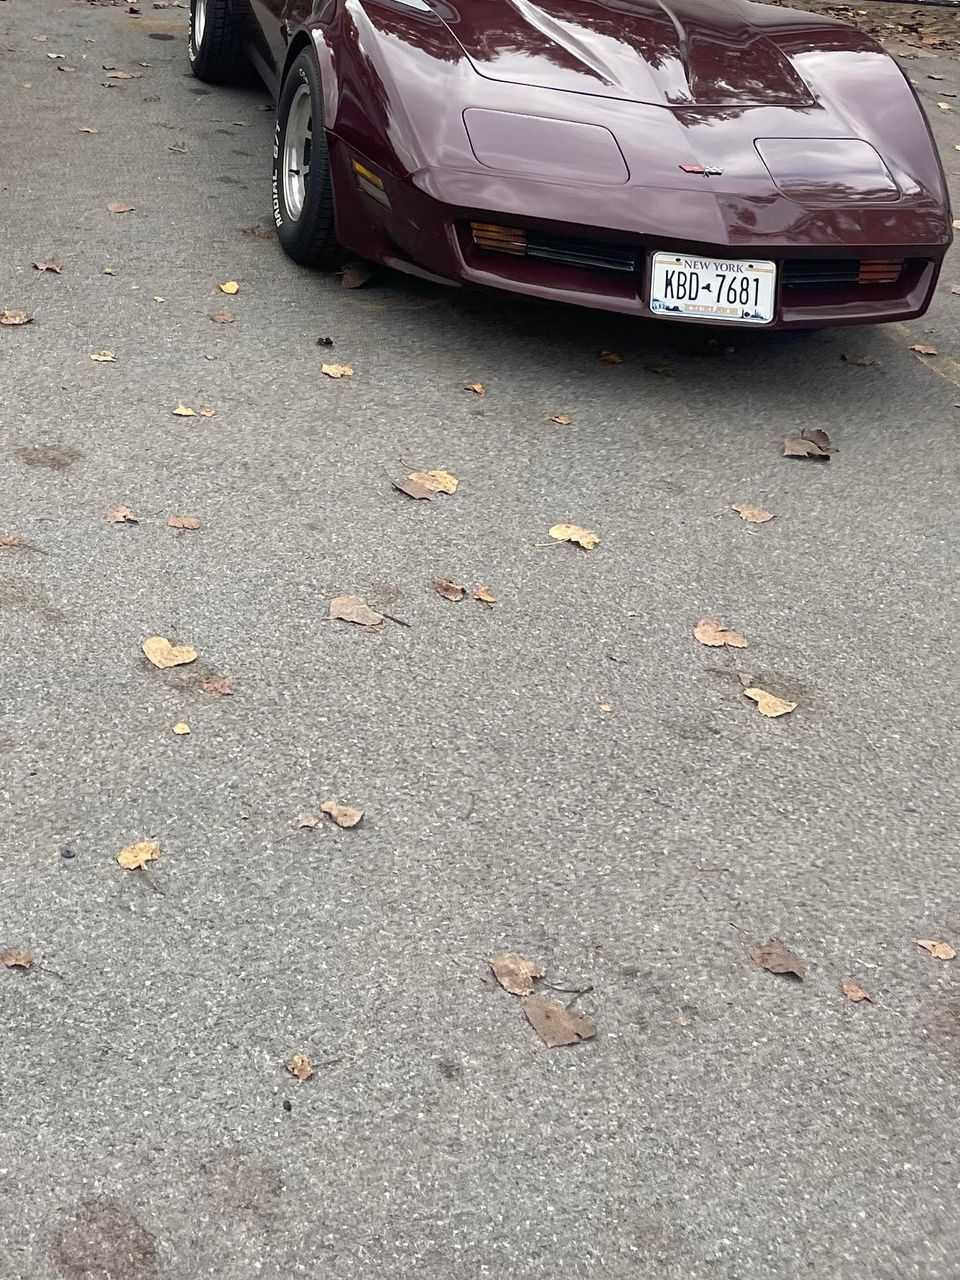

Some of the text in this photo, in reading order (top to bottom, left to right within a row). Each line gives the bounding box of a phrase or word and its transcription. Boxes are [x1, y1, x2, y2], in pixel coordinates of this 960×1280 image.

[271, 168, 284, 228] RADIAL
[683, 259, 745, 274] NEW YORK
[664, 270, 759, 306] KBD 7681
